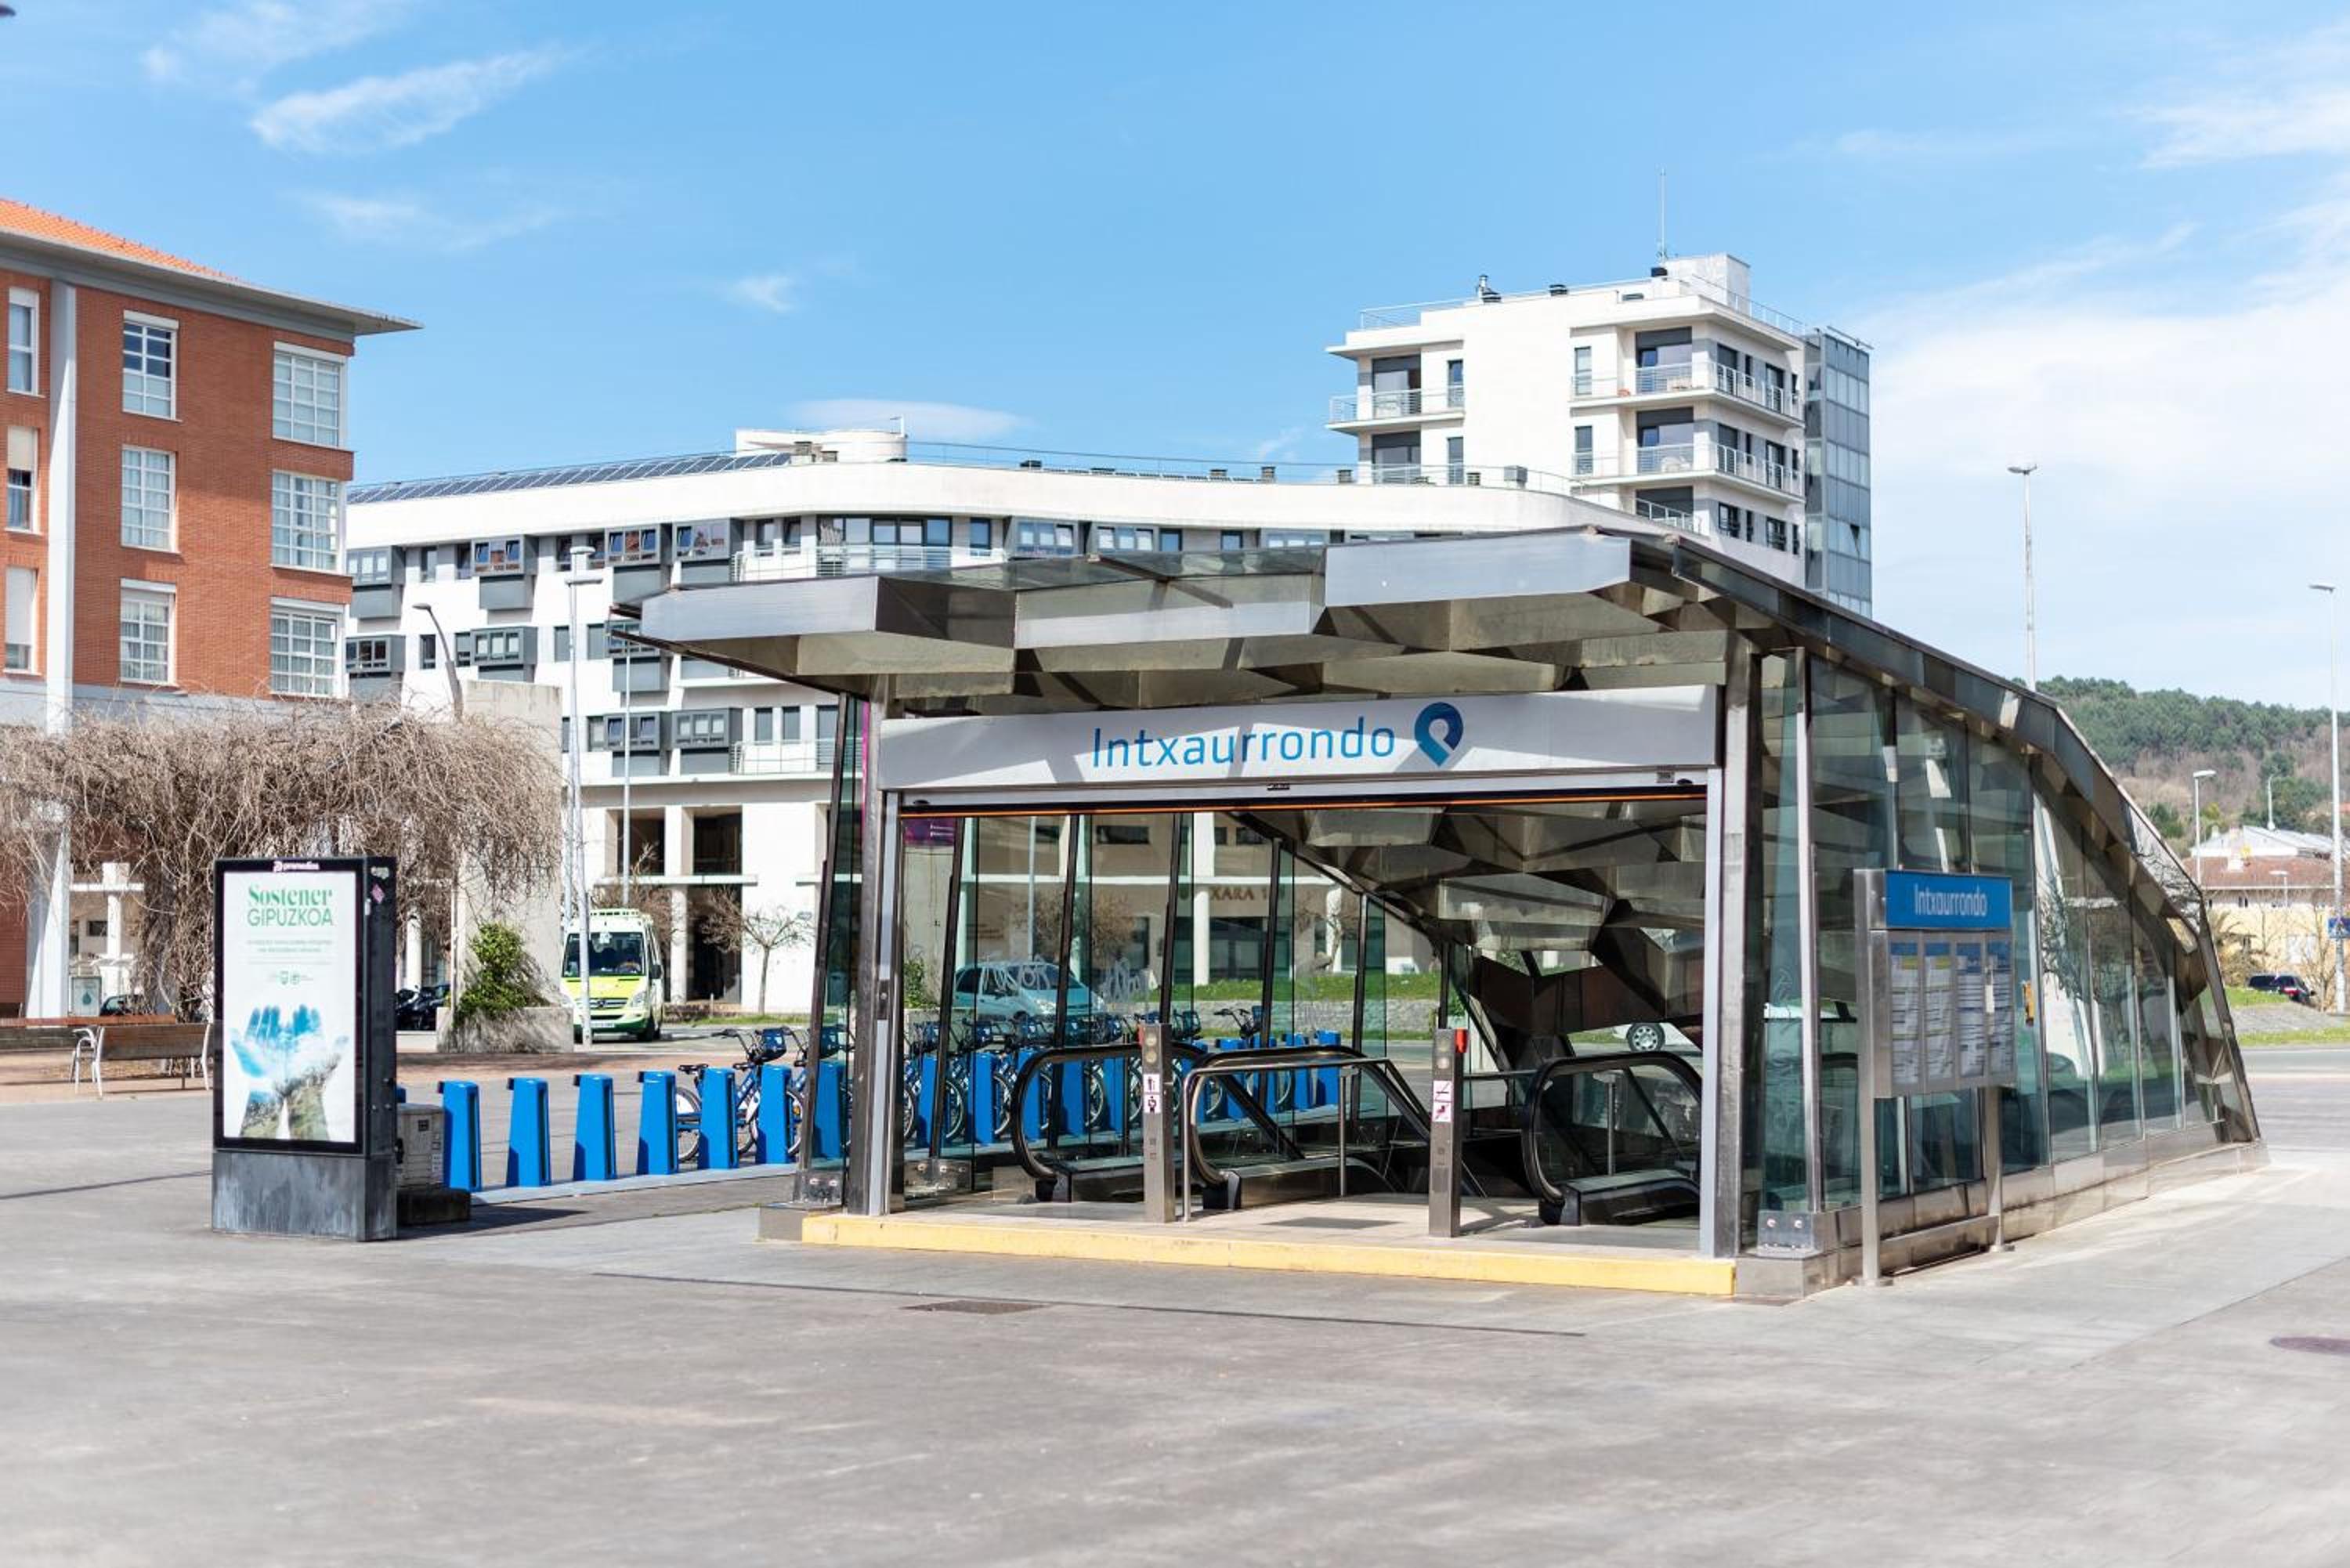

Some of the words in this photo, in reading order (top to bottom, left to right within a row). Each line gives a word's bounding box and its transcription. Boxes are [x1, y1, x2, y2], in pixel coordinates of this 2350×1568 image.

[1092, 716, 1394, 768] Intxaurrondo
[248, 884, 332, 905] Sostener
[1914, 883, 1987, 917] Intxaurrondo
[248, 908, 333, 926] GIPUZKOA
